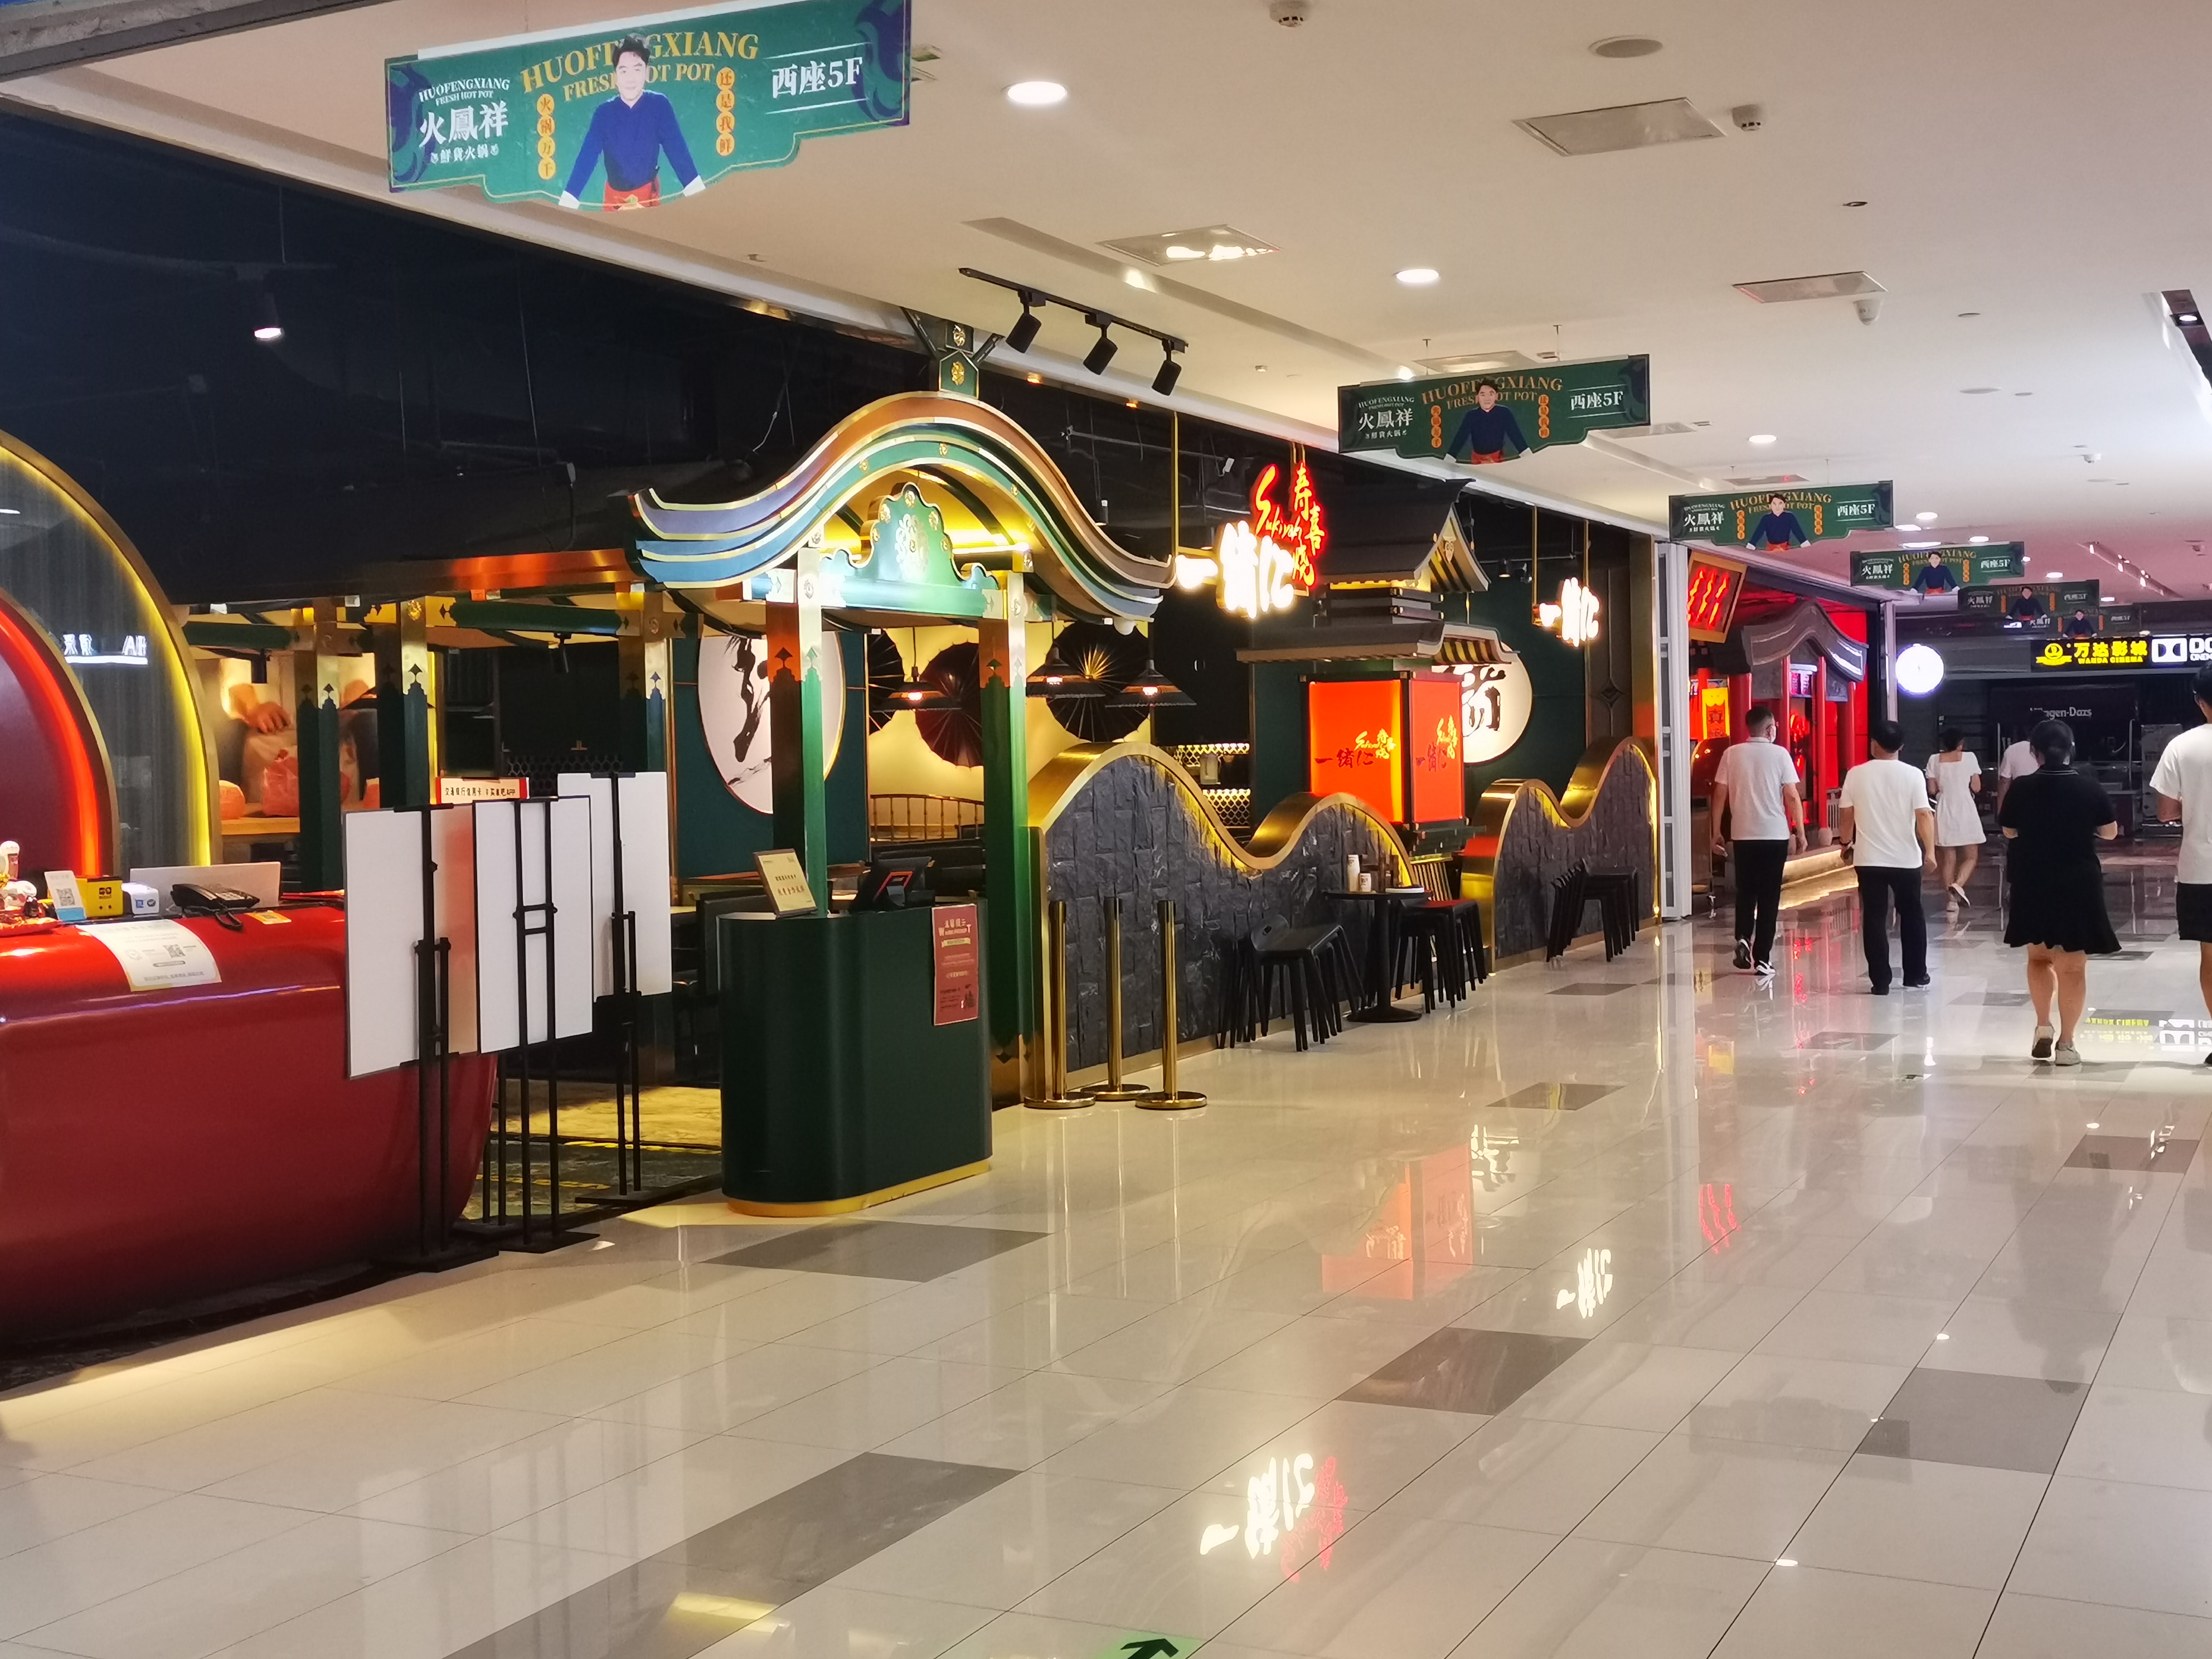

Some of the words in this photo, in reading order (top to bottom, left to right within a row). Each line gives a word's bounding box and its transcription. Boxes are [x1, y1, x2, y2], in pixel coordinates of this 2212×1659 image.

[521, 31, 758, 94] HUOFGXIANG
[646, 64, 671, 83] OT
[675, 63, 714, 81] POT
[772, 57, 862, 99] 西座5F
[419, 77, 510, 103] HUOFENGXIANG
[435, 92, 459, 106] FRESH
[461, 90, 477, 100] HOT
[478, 90, 494, 99] POT
[419, 100, 508, 148] 火鳳祥
[1422, 376, 1563, 404] HUOFGXIANG
[1497, 392, 1512, 401] OT
[1570, 391, 1623, 410] 西座5F
[2074, 641, 2147, 657] 万达影城
[2030, 706, 2092, 721] gen-Dazs
